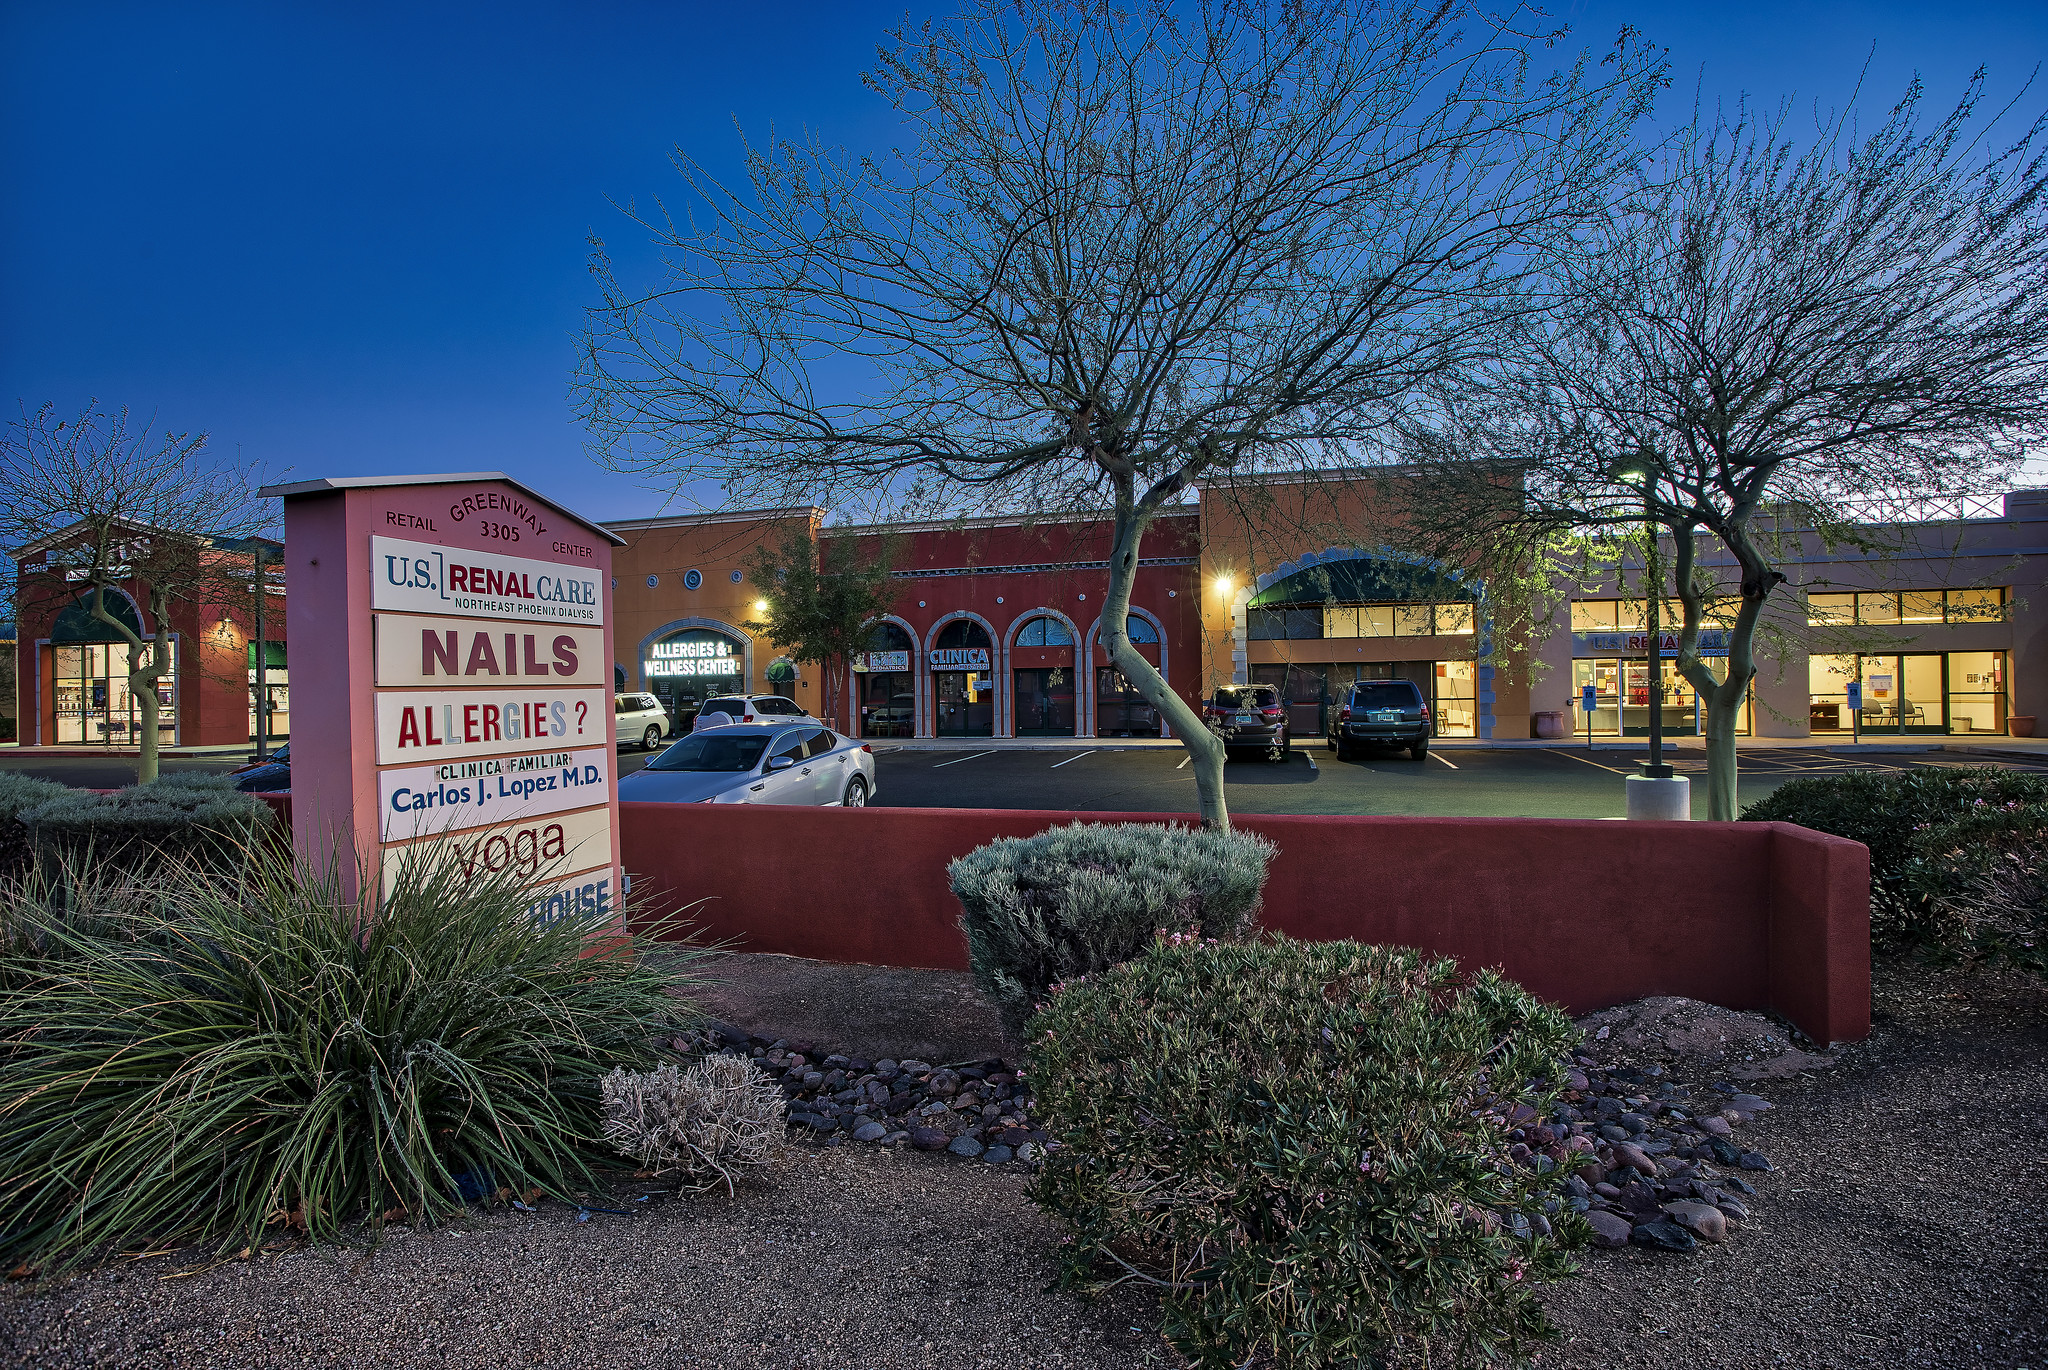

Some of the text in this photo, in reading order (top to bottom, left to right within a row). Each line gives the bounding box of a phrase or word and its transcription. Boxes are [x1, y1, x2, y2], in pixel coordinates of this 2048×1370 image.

[386, 511, 437, 532] RETAIL
[450, 492, 547, 537] GREENWAY
[480, 520, 520, 543] 3305
[552, 541, 593, 558] CENTER
[385, 554, 596, 606] U.S. RENAL CARE
[455, 597, 594, 620] NORTHEAST PHOENIX DIALYSIS
[421, 629, 579, 677] NAILS
[652, 641, 728, 659] ALLERGIES &
[1593, 636, 1622, 650] U.S.
[644, 658, 736, 677] WELLNESS CENTER
[930, 649, 987, 664] CLINICA
[398, 700, 588, 749] ALLERGIES ?
[440, 753, 569, 781] CLINICA FAMILIAR
[391, 765, 603, 813] Carlos J. Lopez M.D.
[453, 823, 566, 886] yoga
